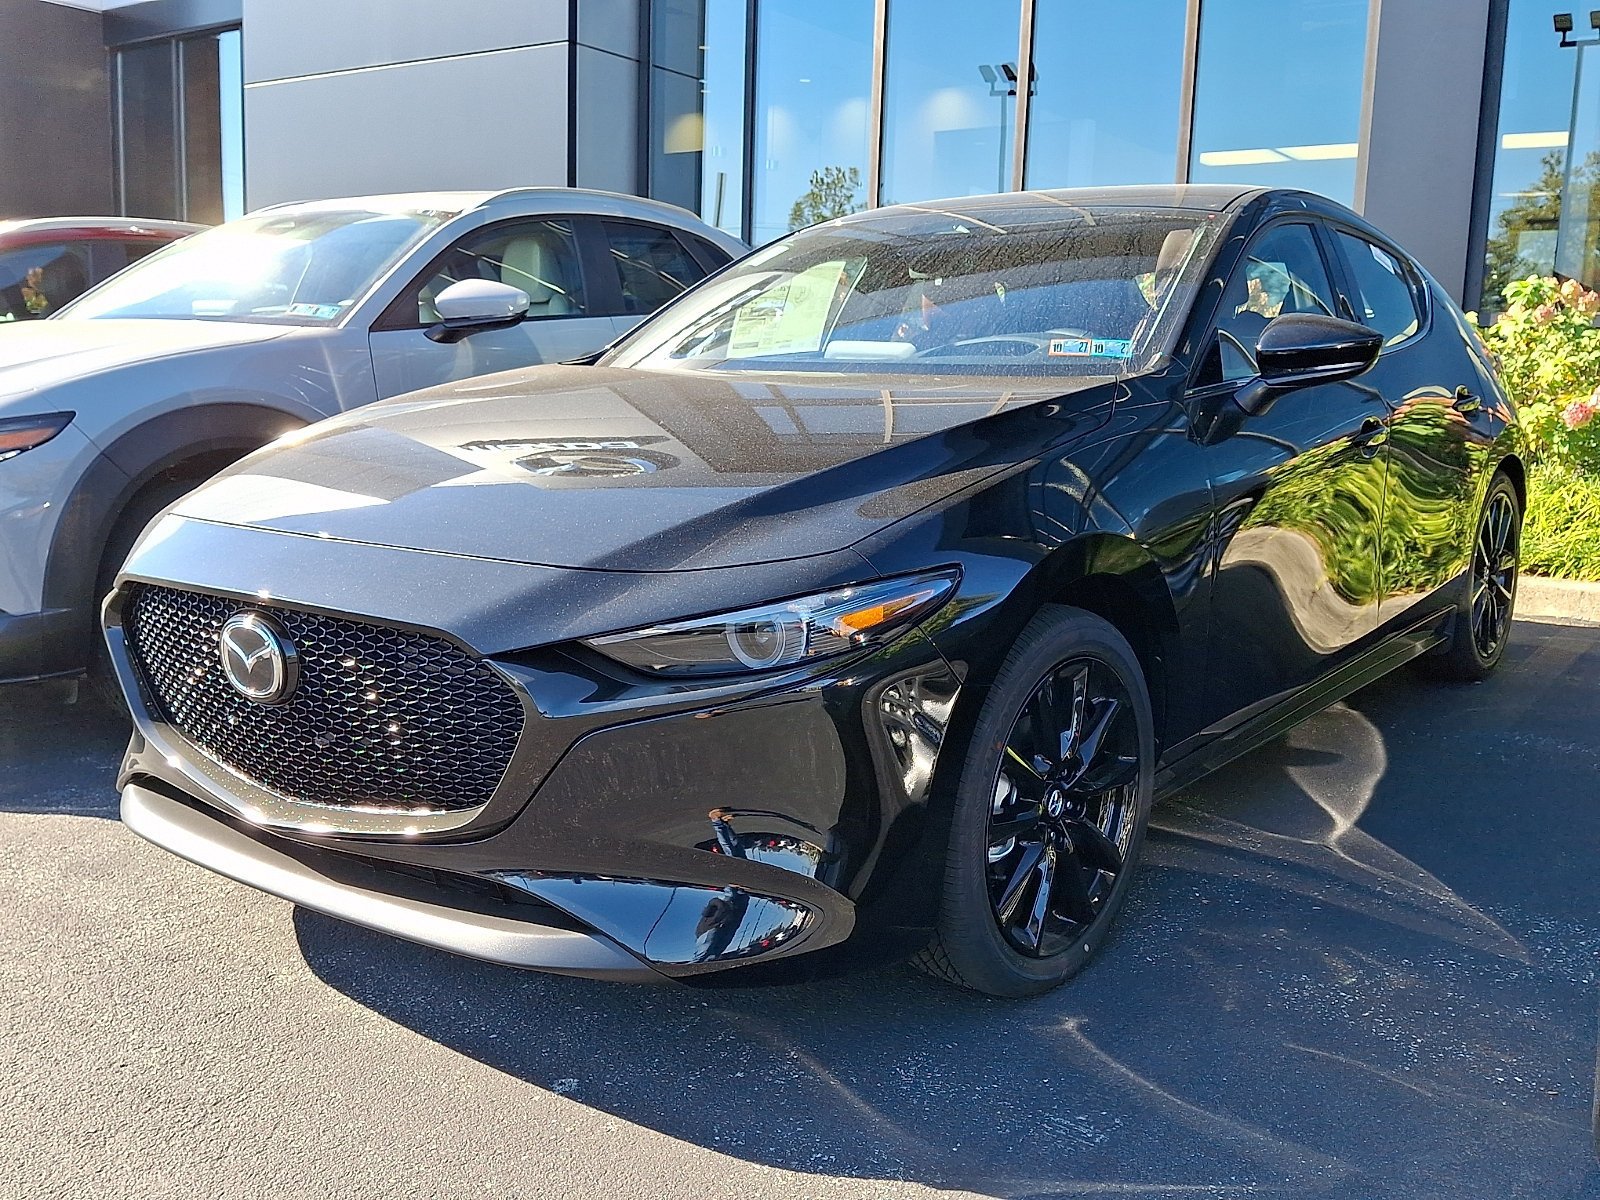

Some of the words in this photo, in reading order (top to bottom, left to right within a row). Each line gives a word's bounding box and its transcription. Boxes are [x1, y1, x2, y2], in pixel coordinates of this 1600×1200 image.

[1053, 343, 1062, 353] 10
[1079, 341, 1088, 353] 27
[1094, 343, 1104, 353] 10
